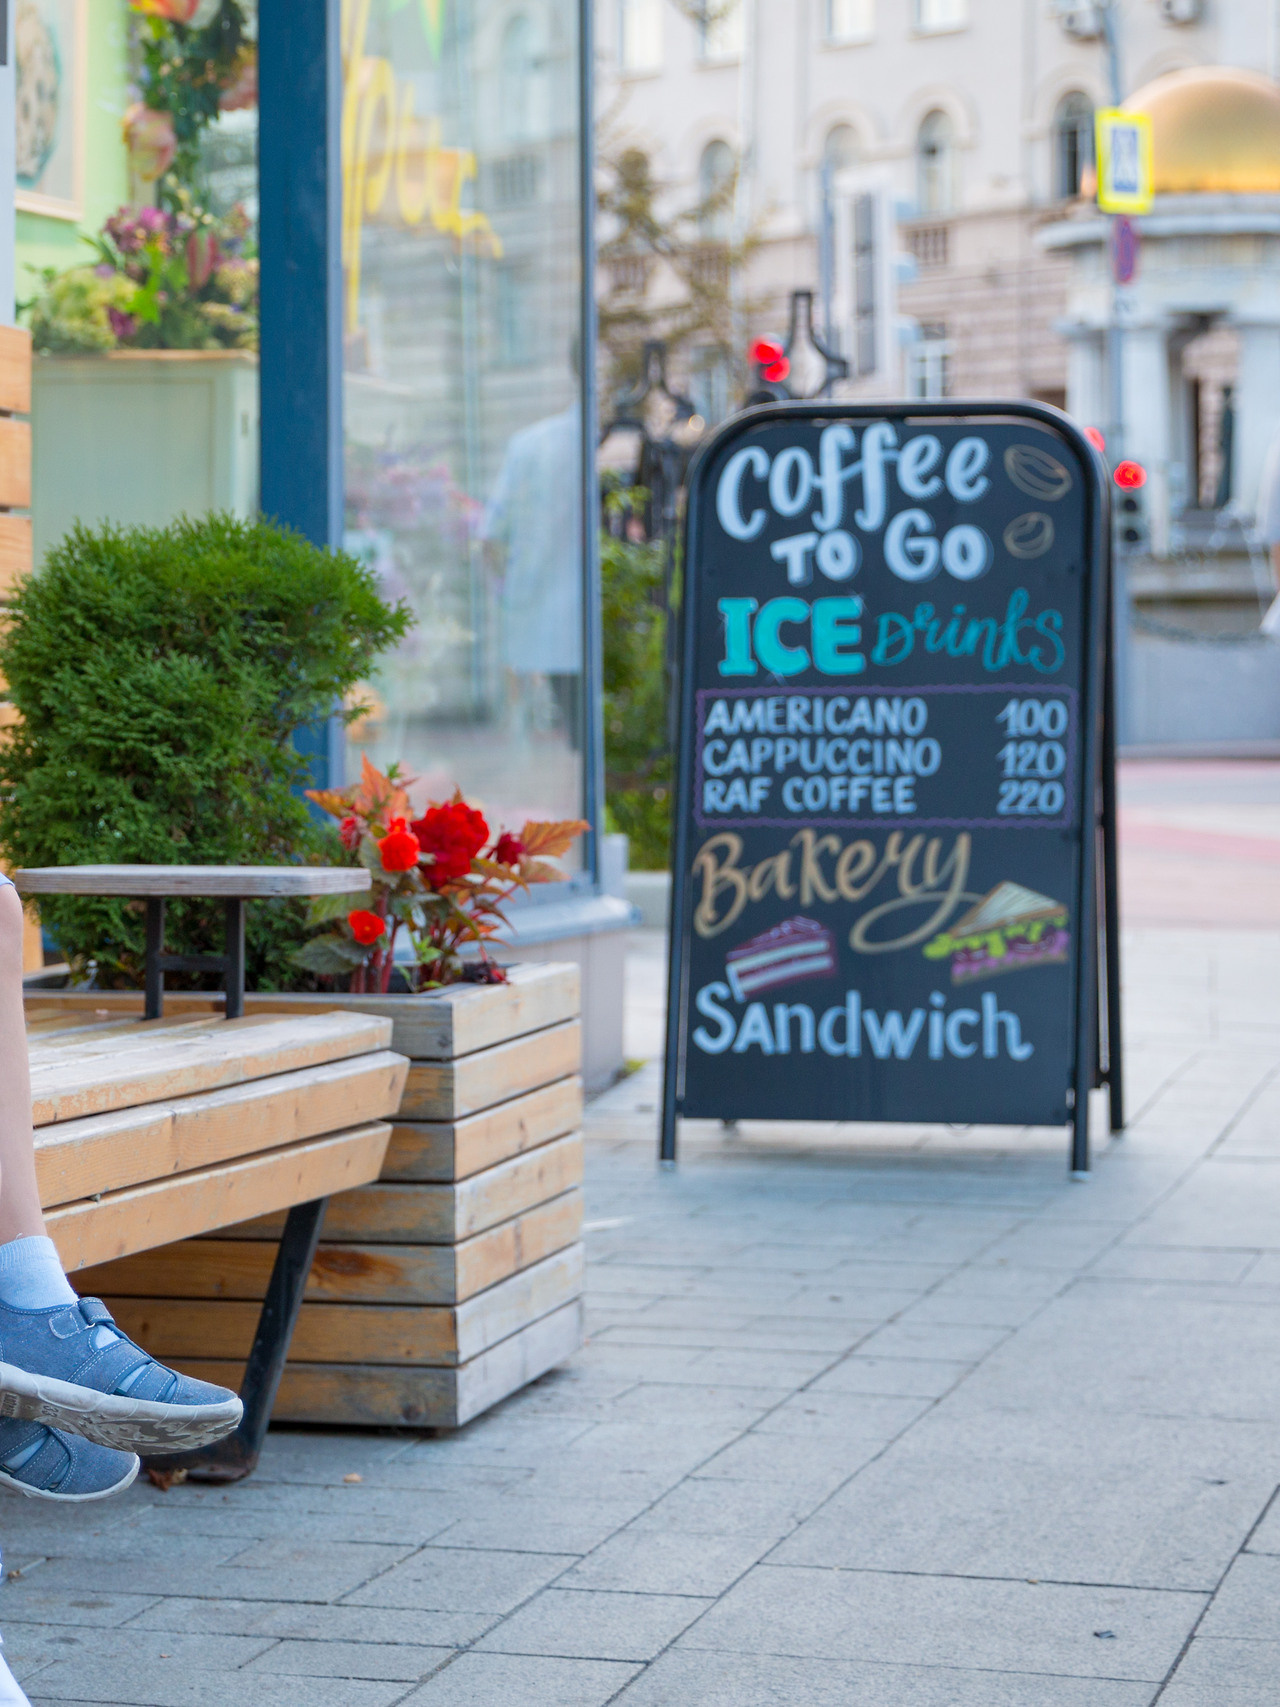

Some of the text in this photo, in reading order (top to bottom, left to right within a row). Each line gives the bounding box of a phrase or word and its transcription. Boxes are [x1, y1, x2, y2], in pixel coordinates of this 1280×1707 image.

[717, 421, 990, 541] Coffee
[718, 596, 866, 677] ICE
[703, 696, 1068, 738] AMERICANO 100
[702, 737, 1067, 778] CAPPUCCINO 120
[702, 775, 1065, 815] RAF COFFEE 220
